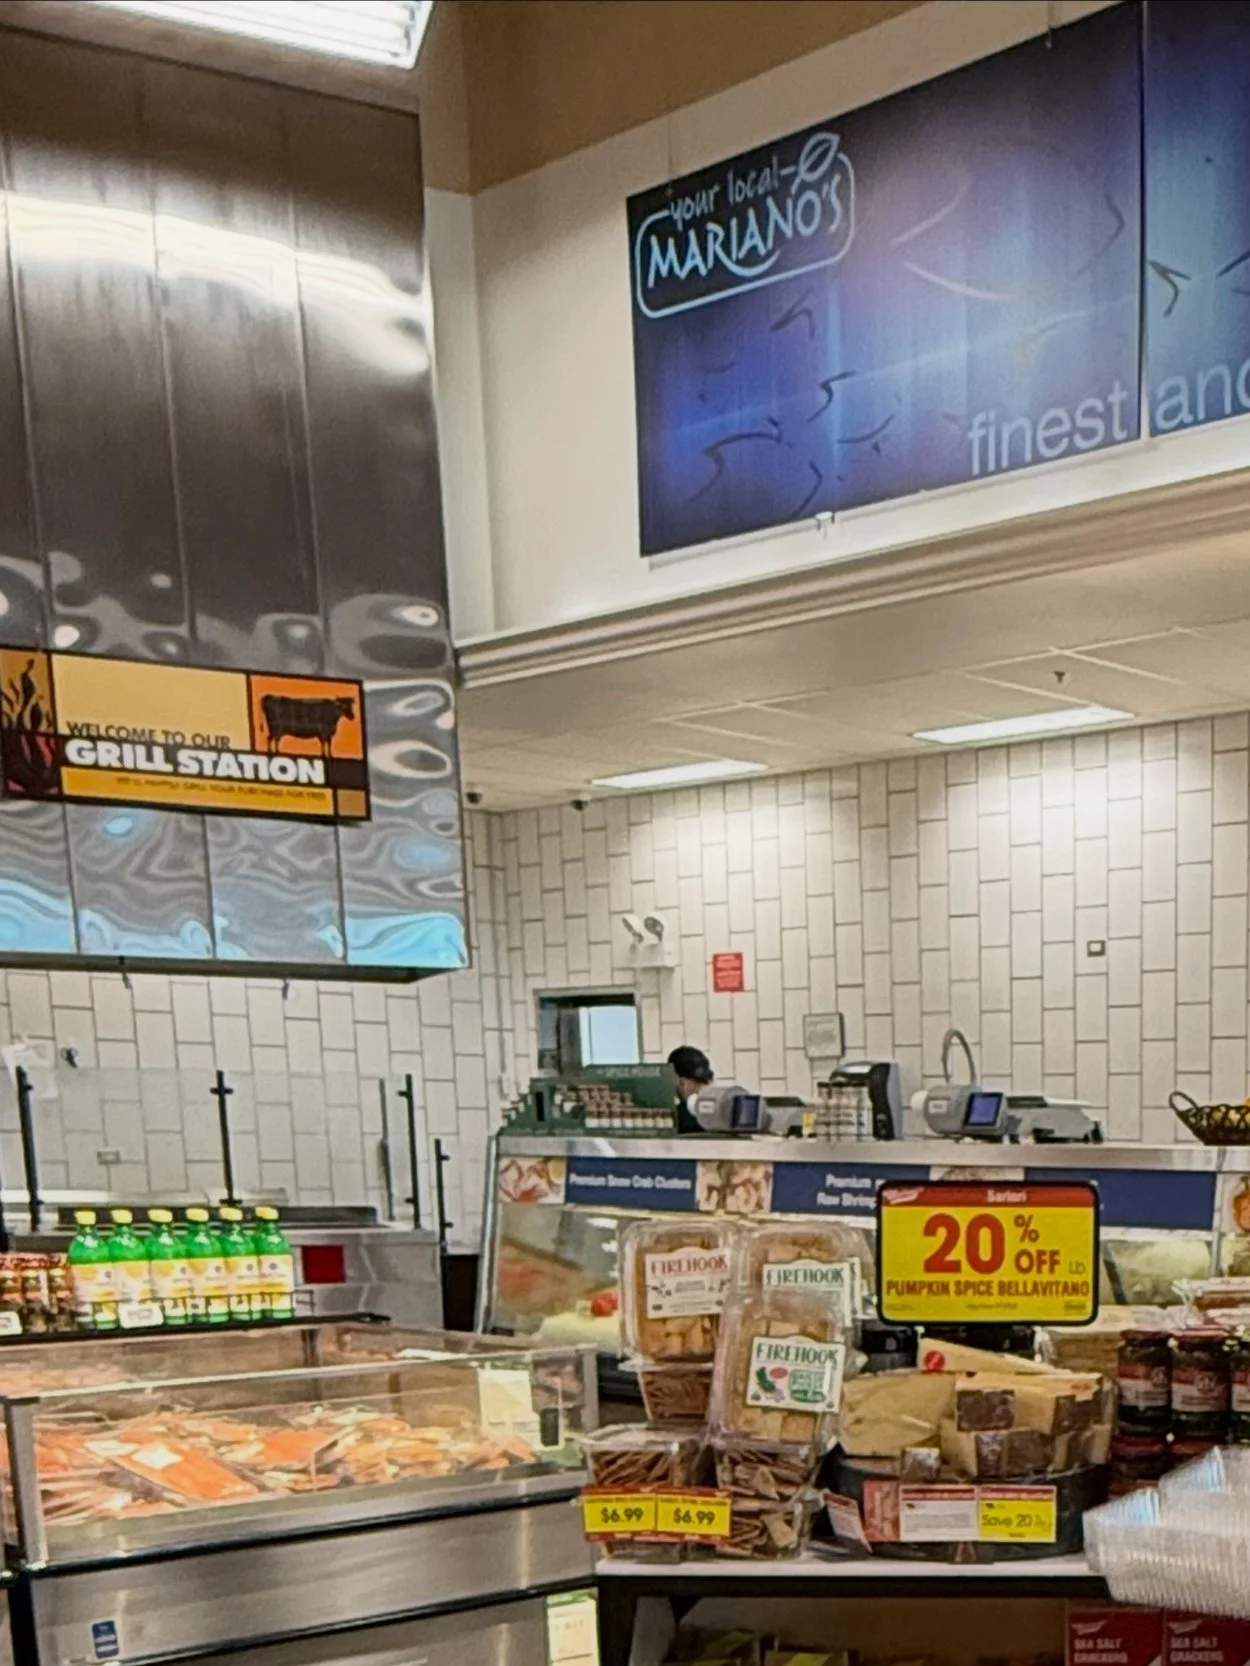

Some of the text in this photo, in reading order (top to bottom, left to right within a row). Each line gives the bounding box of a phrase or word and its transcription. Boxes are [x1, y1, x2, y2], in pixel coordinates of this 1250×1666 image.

[670, 154, 779, 233] your local
[647, 171, 842, 288] MARIANO'S
[966, 380, 1131, 478] finest
[66, 721, 232, 750] WELCOME TO OUR
[64, 737, 326, 785] GRILL STATION
[922, 1213, 1040, 1275] 20 %
[650, 1254, 728, 1276] FIREHOOK
[1014, 1249, 1061, 1275] OFF
[765, 1267, 845, 1286] FIREHOOK
[886, 1279, 1090, 1297] PUMPKIN SPICE BELLAVITANO
[755, 1341, 840, 1367] FIREHOOK
[600, 1506, 644, 1524] $6.99
[673, 1507, 716, 1526] $6.99
